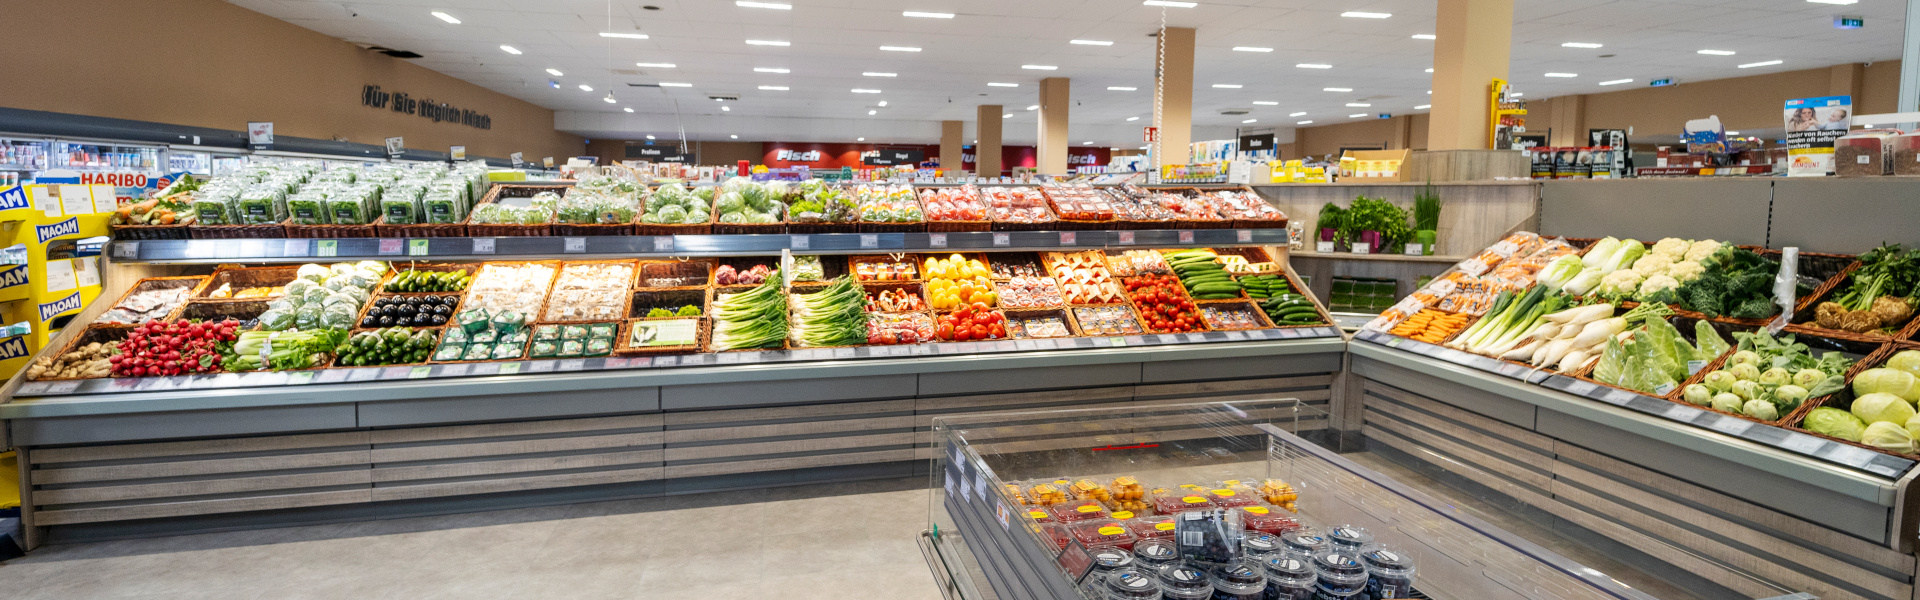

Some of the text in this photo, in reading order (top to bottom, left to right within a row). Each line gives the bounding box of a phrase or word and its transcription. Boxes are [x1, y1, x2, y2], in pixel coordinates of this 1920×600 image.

[362, 85, 389, 109] Für
[391, 92, 417, 115] Sie
[418, 99, 461, 123] täglich
[776, 149, 821, 162] Fisch
[1067, 153, 1097, 165] isch
[81, 173, 147, 187] HARIBO
[39, 219, 78, 241] MAOAM
[319, 246, 337, 257] BIO
[410, 246, 427, 256] BIO
[42, 294, 80, 320] MAOAM
